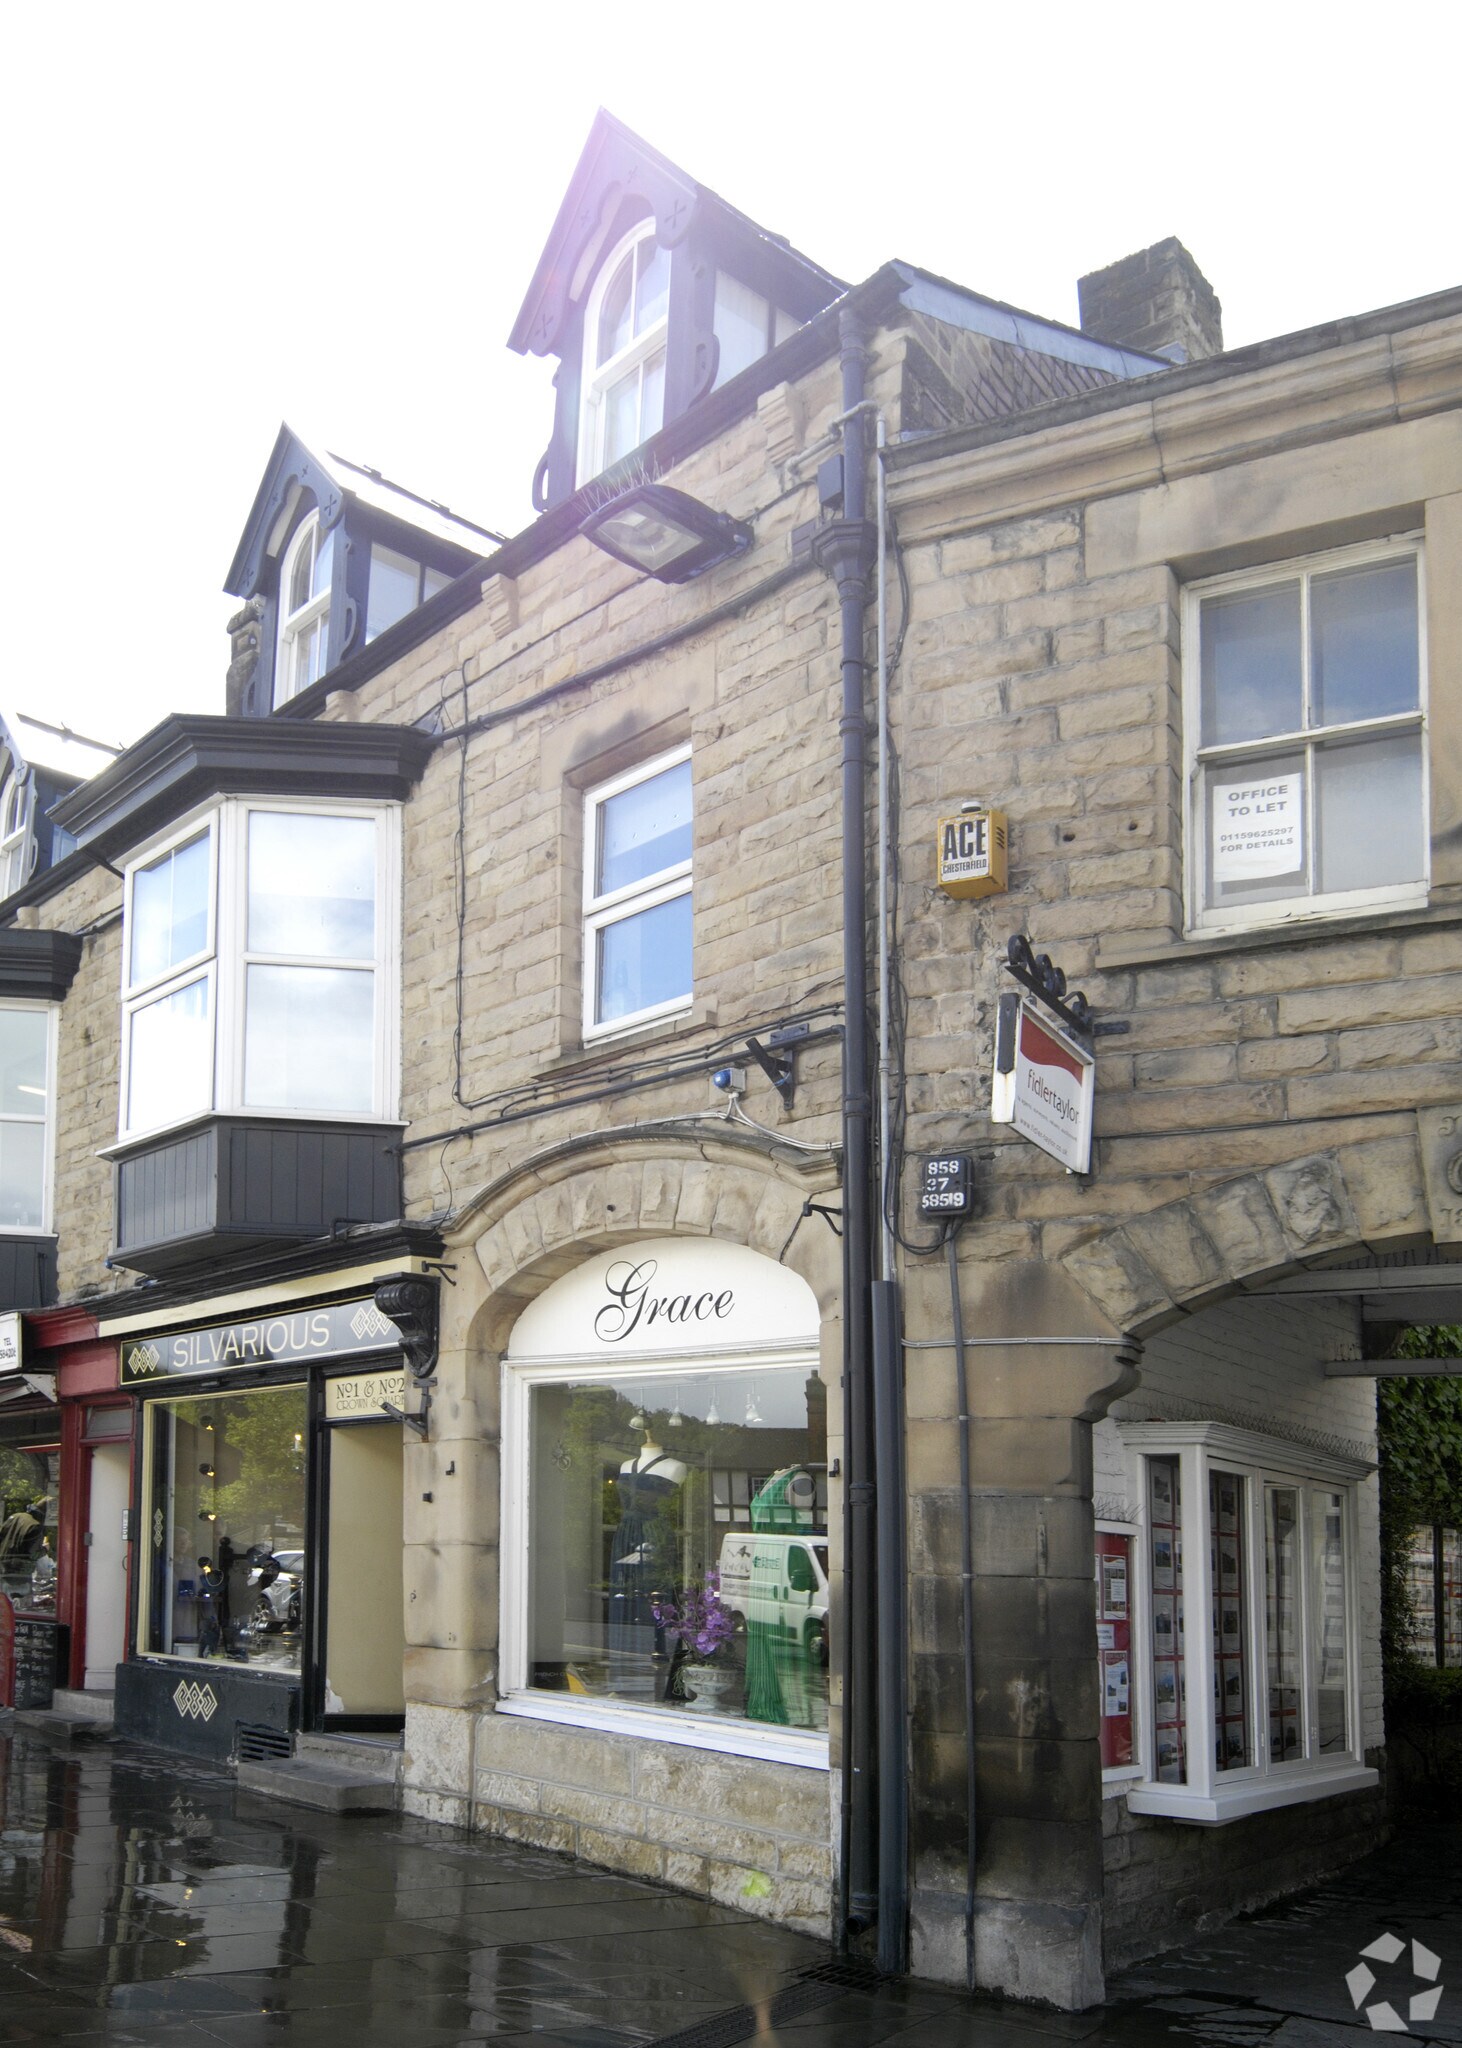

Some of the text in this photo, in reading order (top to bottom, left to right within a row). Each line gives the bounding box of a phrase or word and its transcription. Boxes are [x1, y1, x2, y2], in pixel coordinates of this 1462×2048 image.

[1228, 784, 1288, 802] OFFICE
[1228, 801, 1287, 817] TO LET
[943, 819, 986, 860] ACE
[1220, 826, 1294, 842] 01159625297
[1220, 838, 1294, 853] FOR DETAILS
[942, 859, 987, 874] CHESTERFIELD
[1027, 1068, 1080, 1125] fidlertaylor
[928, 1160, 959, 1175] 858
[927, 1177, 949, 1191] 37
[922, 1192, 964, 1208] 58519
[594, 1259, 735, 1342] Grace
[173, 1313, 330, 1367] SILVARIOUS
[364, 1380, 375, 1398] &
[336, 1398, 368, 1410] CROWN
